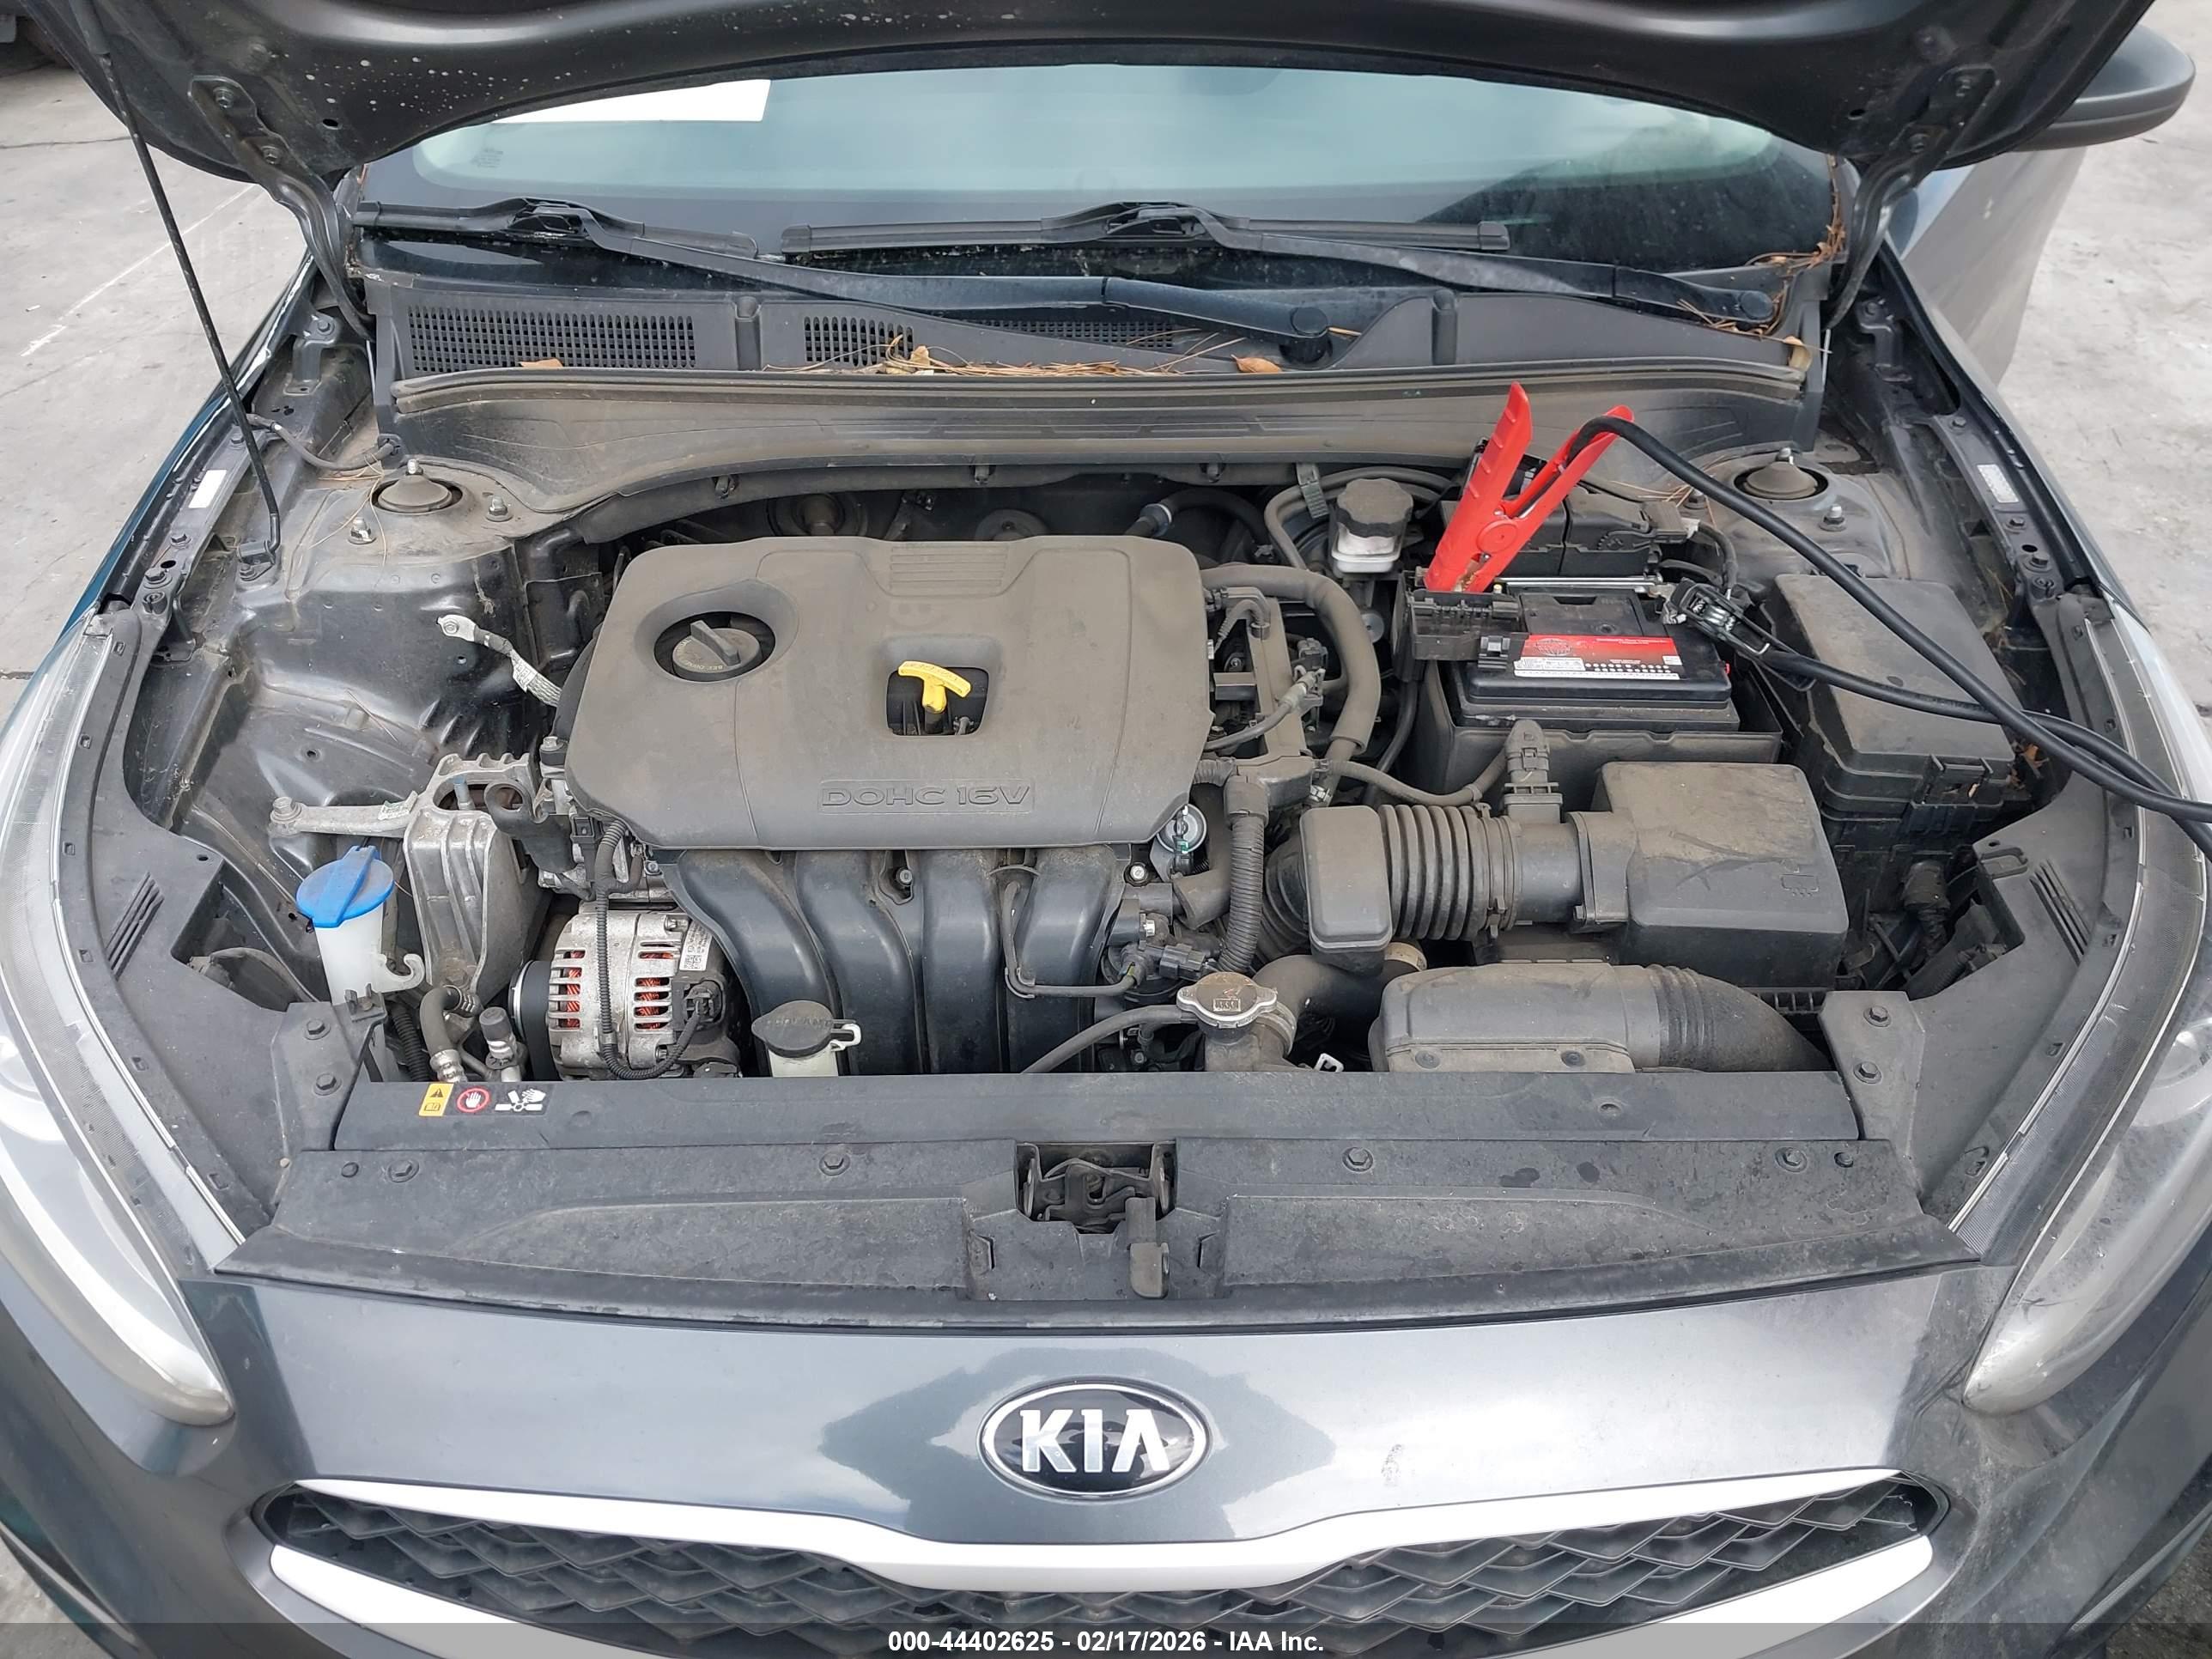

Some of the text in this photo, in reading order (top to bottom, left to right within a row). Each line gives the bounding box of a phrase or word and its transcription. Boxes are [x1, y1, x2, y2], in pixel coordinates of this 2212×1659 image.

[821, 785, 1030, 806] DOHC 16V
[1019, 1408, 1171, 1474] KIA
